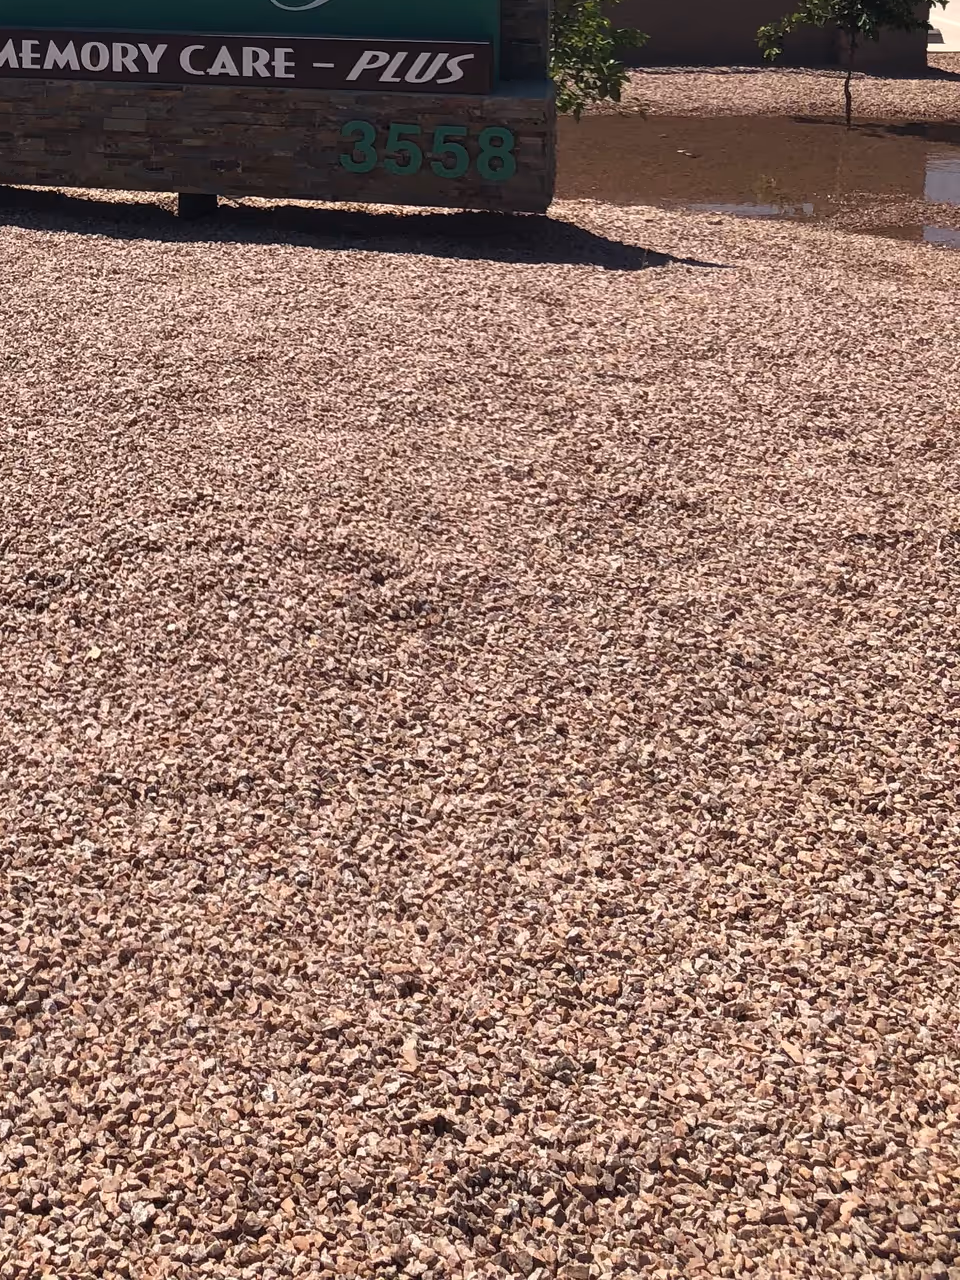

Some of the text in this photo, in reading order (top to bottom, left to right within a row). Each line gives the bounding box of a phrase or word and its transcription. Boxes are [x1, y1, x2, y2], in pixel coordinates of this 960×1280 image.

[179, 44, 296, 78] CARE
[346, 51, 474, 84] PLUS
[341, 122, 516, 180] 3558
